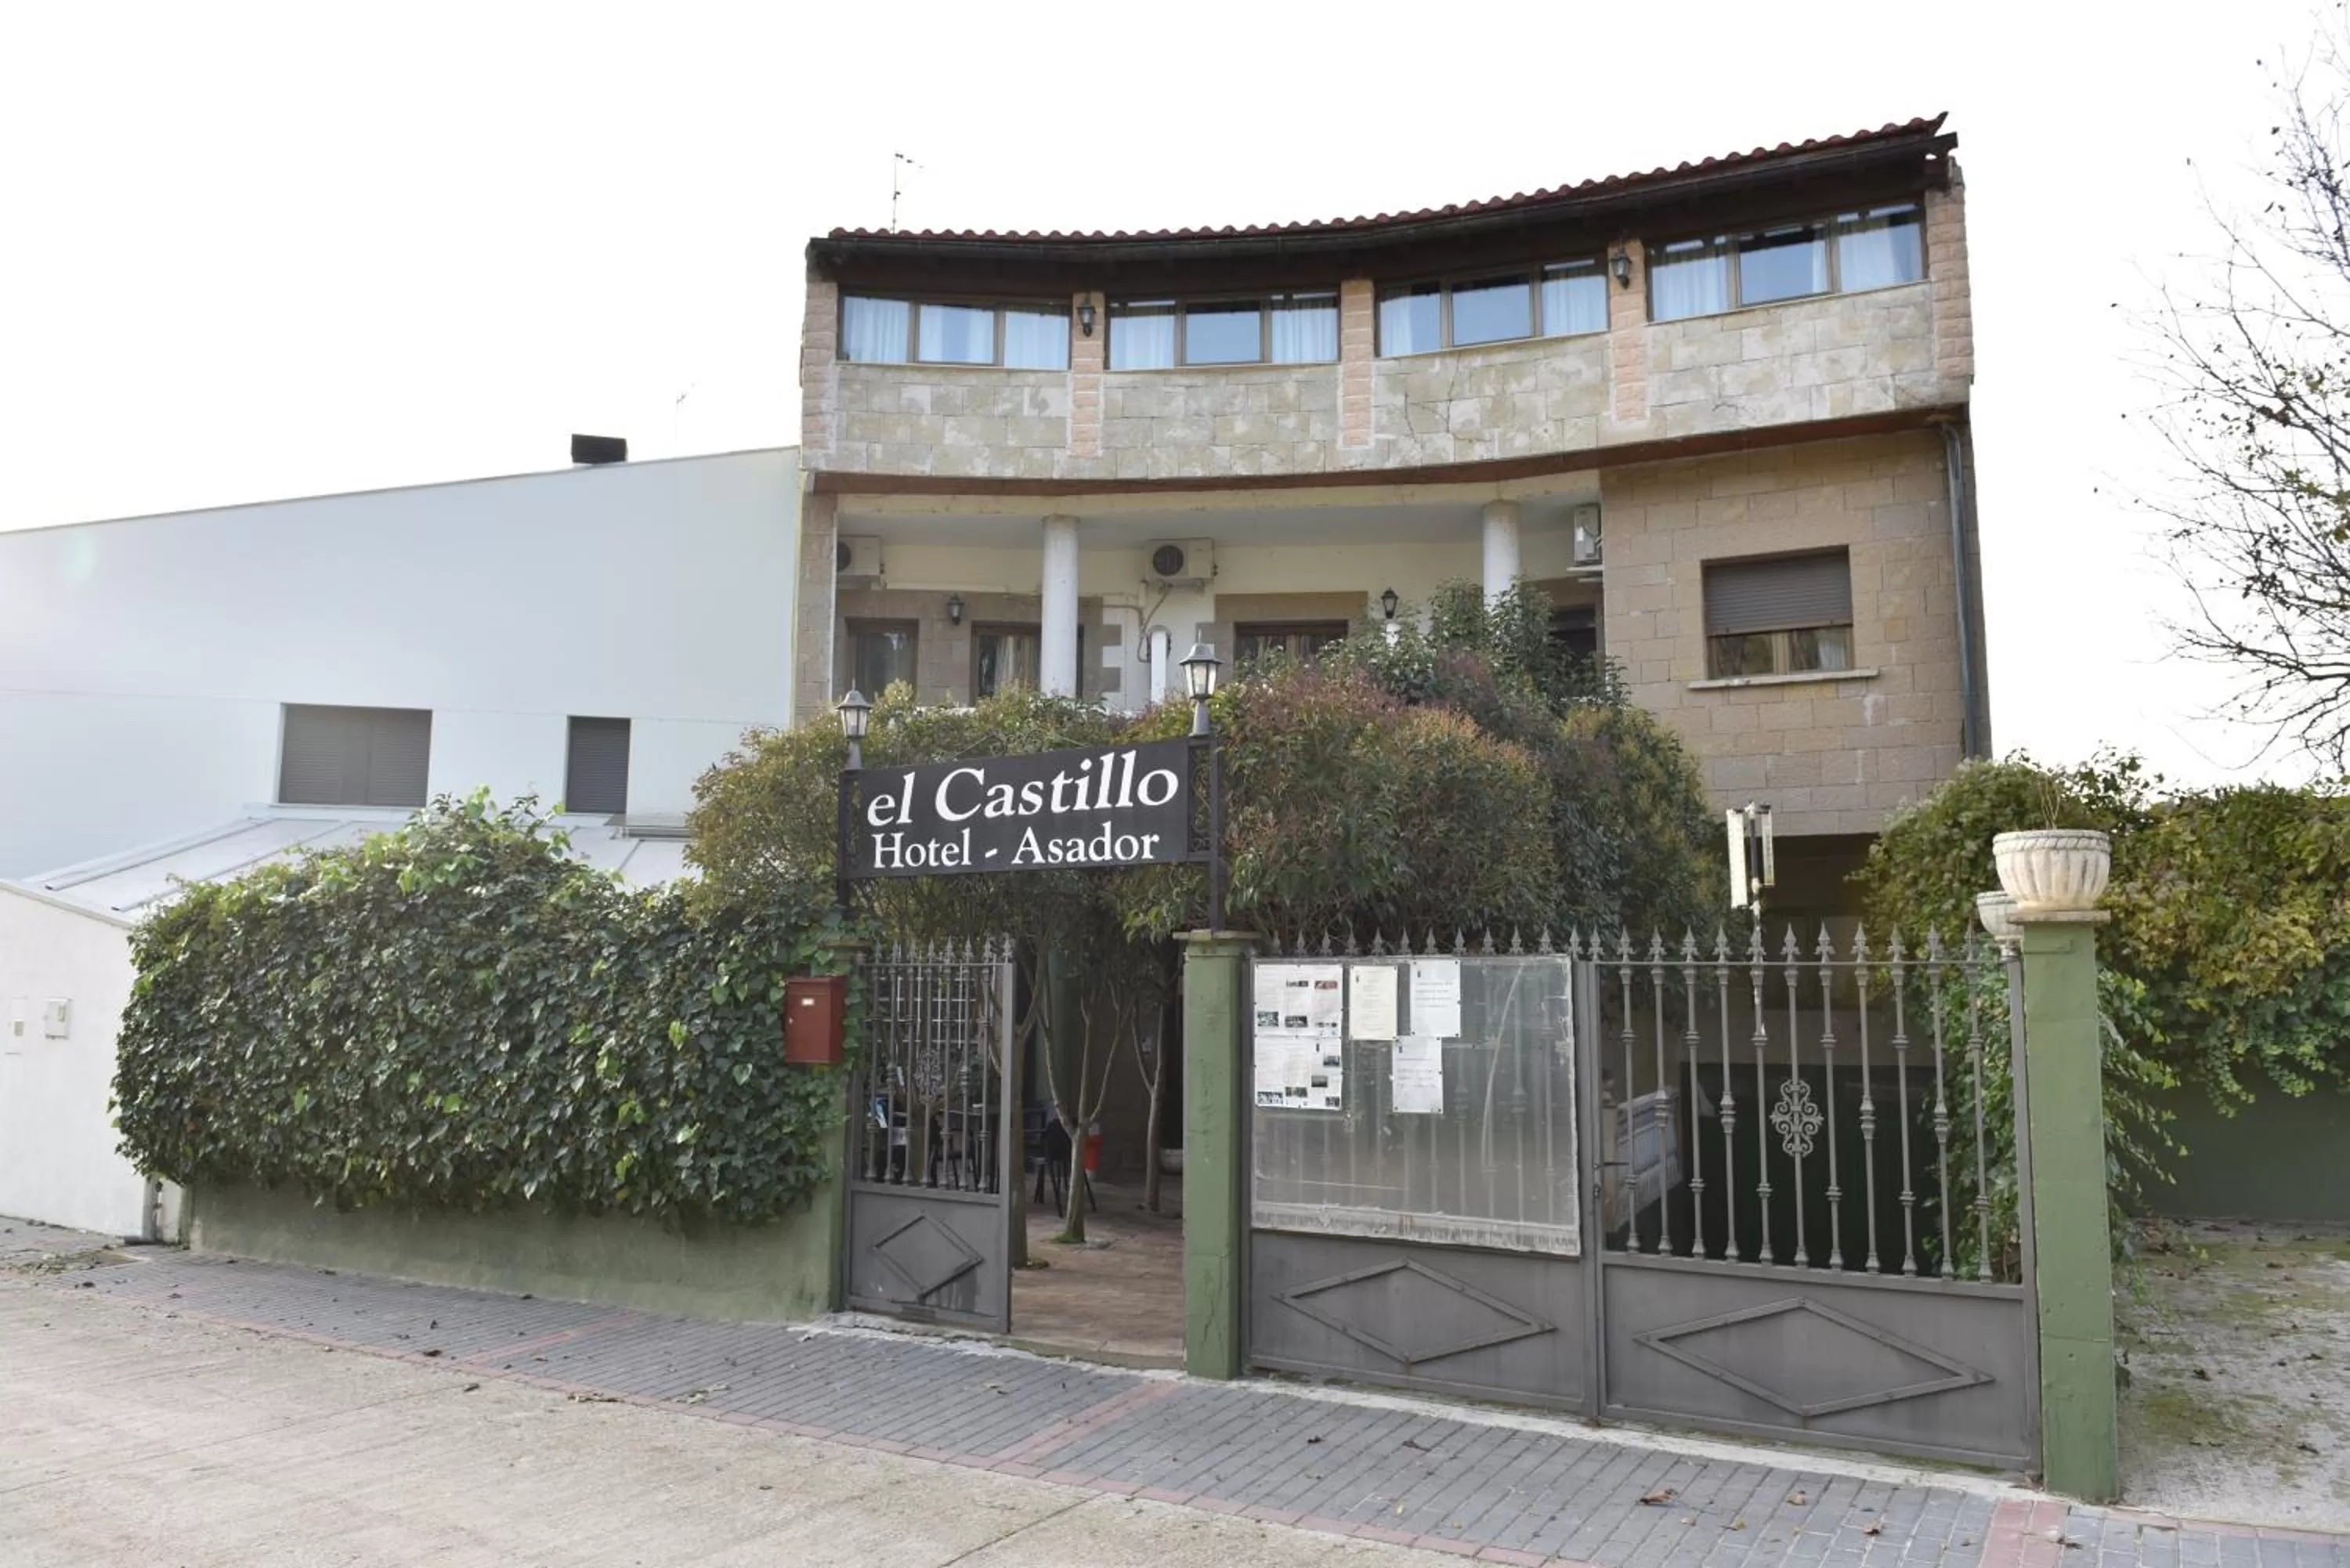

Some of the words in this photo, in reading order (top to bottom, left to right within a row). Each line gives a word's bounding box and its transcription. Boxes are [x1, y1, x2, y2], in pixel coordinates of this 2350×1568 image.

[867, 771, 916, 826] el
[935, 750, 1179, 822] Castillo
[872, 827, 971, 869] Hotel
[985, 848, 998, 858] -
[1011, 820, 1160, 864] Asador
